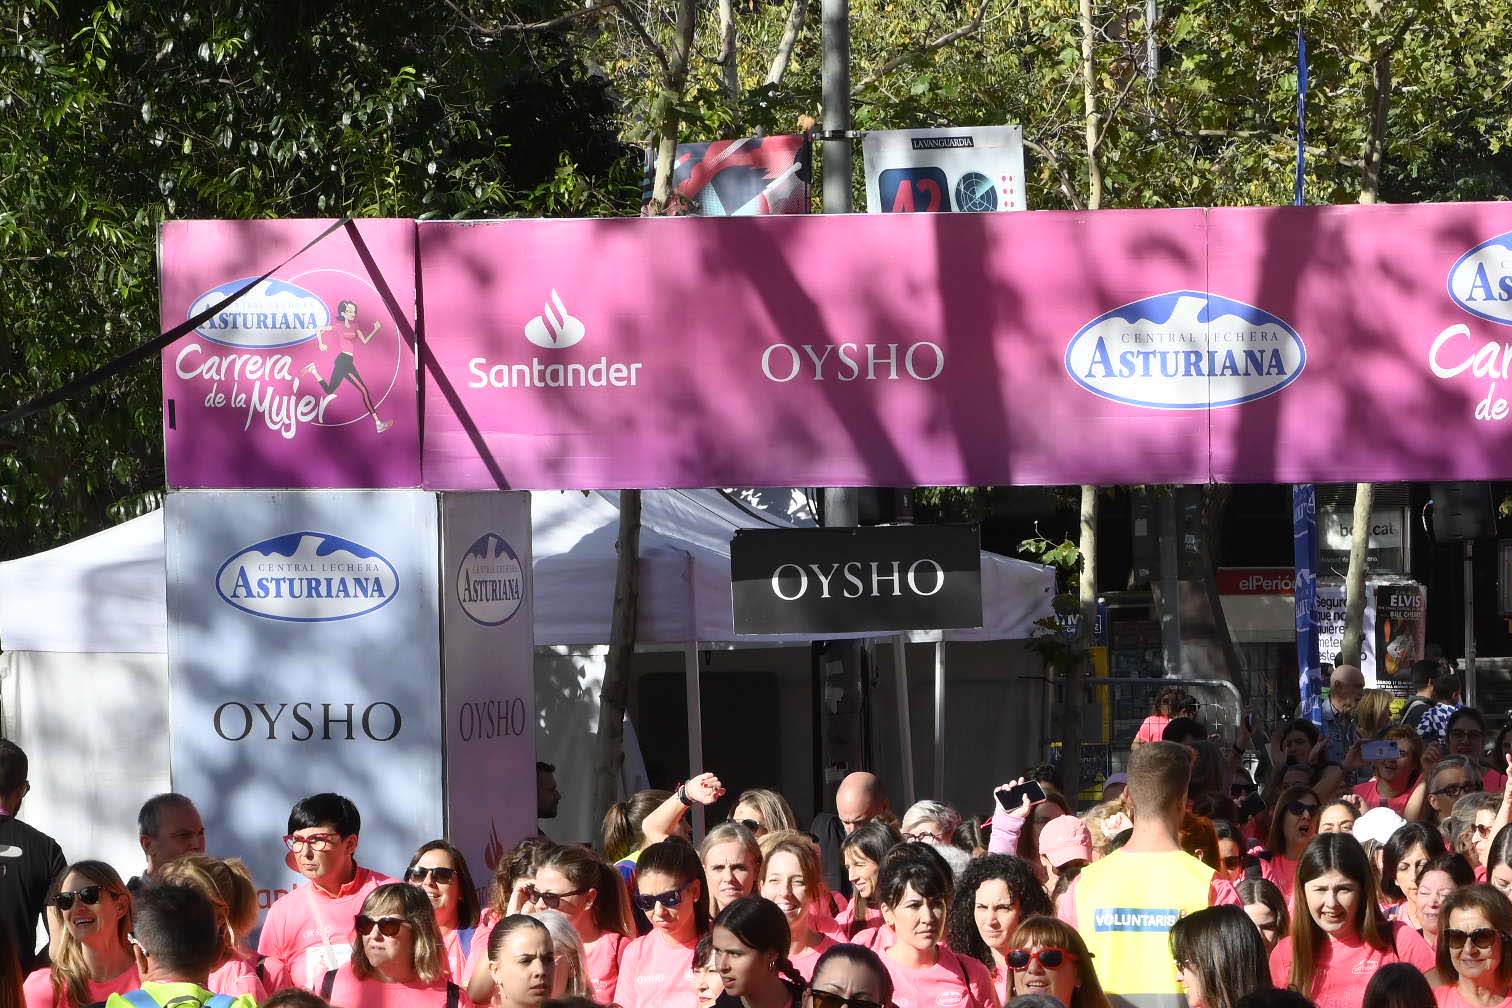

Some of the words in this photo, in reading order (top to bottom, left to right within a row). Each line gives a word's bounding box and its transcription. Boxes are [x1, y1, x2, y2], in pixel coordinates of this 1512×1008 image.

[1121, 332, 1197, 344] CENTRAL
[1203, 330, 1280, 343] LECHERA
[175, 343, 292, 380] Carrera
[468, 356, 643, 389] Santander
[761, 341, 946, 383] OYSHO
[1084, 335, 1288, 379] ASTURIANA
[204, 382, 226, 408] de
[231, 379, 246, 408] la
[244, 378, 337, 440] Mujer
[1474, 380, 1509, 421] de
[230, 565, 386, 599] ASTURIANA
[258, 563, 315, 572] CENTRAL
[322, 563, 380, 572] LECHERA
[462, 567, 520, 602] ASTURIANA
[771, 558, 945, 601] OYSHO
[1390, 594, 1421, 608] ELVIS
[213, 700, 402, 742] OYSHO
[459, 697, 526, 742] OYSHO
